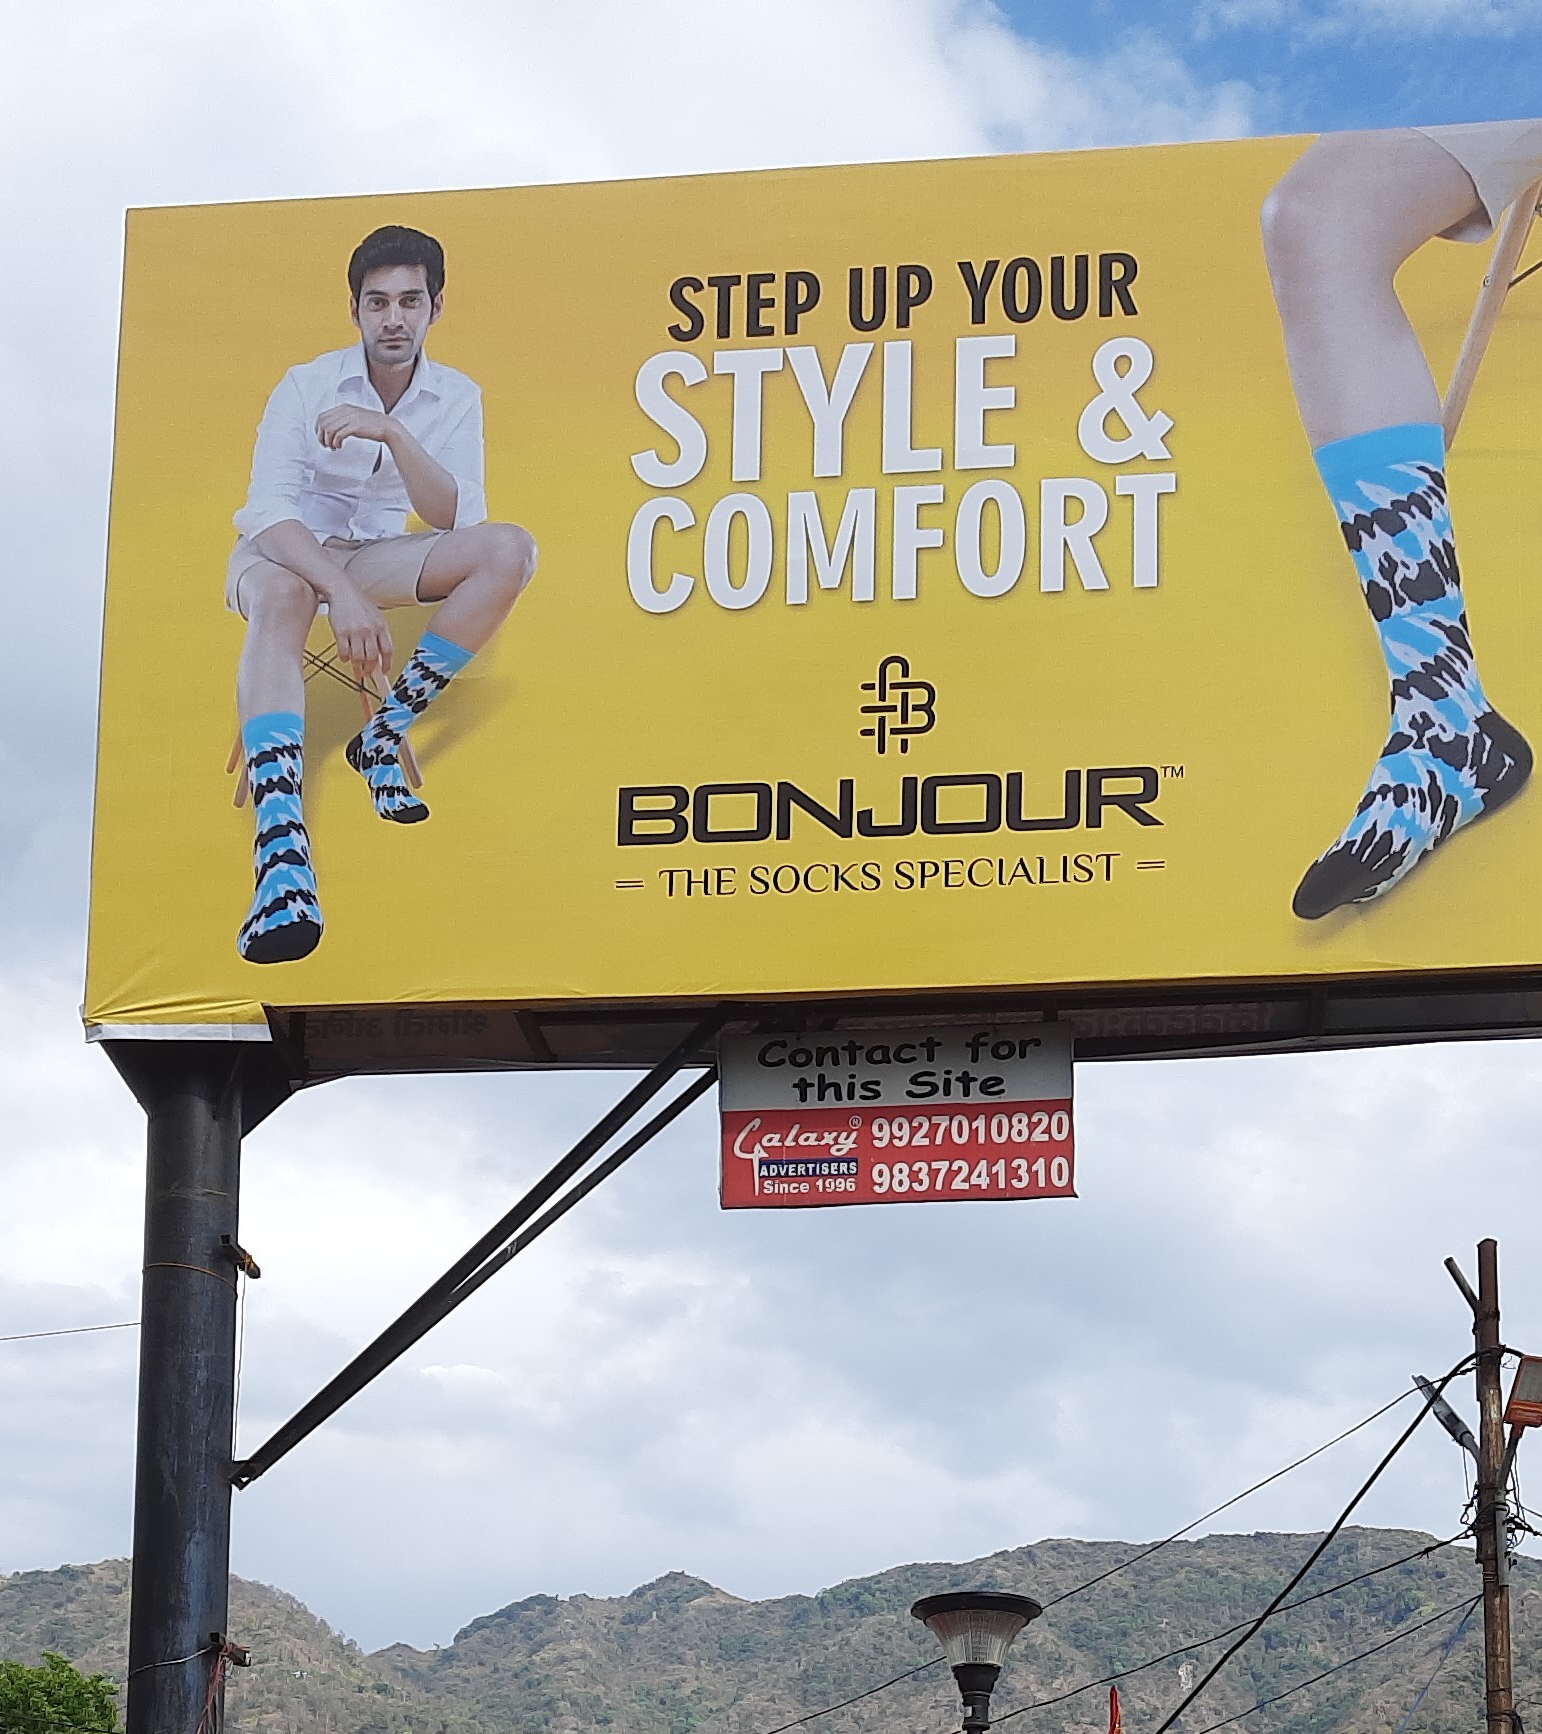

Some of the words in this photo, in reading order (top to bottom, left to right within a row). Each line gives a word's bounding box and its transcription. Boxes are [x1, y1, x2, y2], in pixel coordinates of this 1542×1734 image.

[667, 270, 820, 341] STEP
[848, 265, 933, 331] UP
[958, 252, 1139, 324] YOUR
[630, 334, 1016, 489] STYLE
[1077, 336, 1175, 463] &
[626, 472, 1176, 614] COMFORT
[659, 867, 737, 897] THE
[749, 861, 882, 894] SOCKS
[895, 853, 1121, 888] SPECIALIST
[758, 1036, 942, 1068] Contact
[965, 1033, 1042, 1063] for
[793, 1074, 881, 1102] this
[906, 1070, 1006, 1099] Site
[872, 1111, 1070, 1148] 9927010820
[759, 1161, 857, 1177] ADVERTISERS
[763, 1180, 810, 1194] Since
[816, 1179, 856, 1193] 1996
[872, 1157, 1070, 1193] 9837241310
